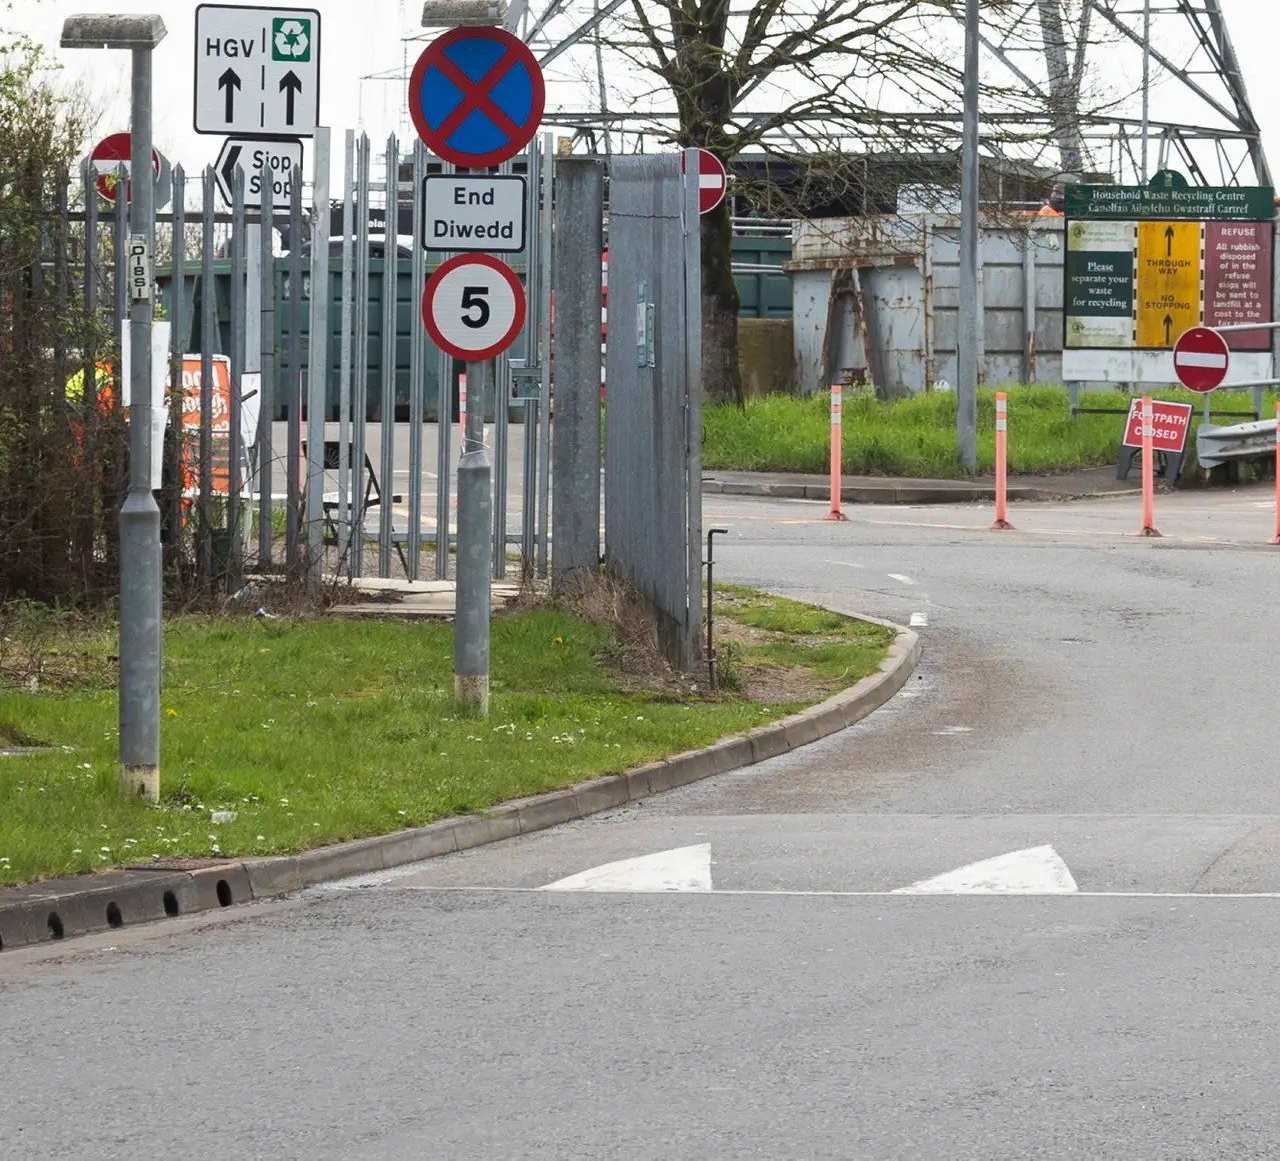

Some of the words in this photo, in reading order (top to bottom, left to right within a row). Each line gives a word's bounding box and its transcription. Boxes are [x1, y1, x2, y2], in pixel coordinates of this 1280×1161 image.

[206, 37, 255, 59] HGV
[252, 149, 291, 173] Siop
[249, 175, 291, 198] Sop
[454, 186, 495, 206] End
[1092, 189, 1141, 201] Household
[1143, 190, 1169, 201] Waste
[1172, 190, 1214, 203] Recycling
[1216, 190, 1246, 201] Centre
[1088, 202, 1128, 214] Canolfan
[1173, 202, 1216, 215] Gwastraff
[1217, 203, 1249, 215] Cartref
[433, 218, 513, 239] Diwedd
[1221, 227, 1256, 237] REFUSE
[1216, 242, 1229, 251] All
[1231, 242, 1261, 251] rubbish
[1220, 252, 1256, 262] disposed
[1087, 261, 1114, 272] Please
[1220, 262, 1229, 271] of
[1232, 262, 1240, 270] in
[1242, 262, 1256, 271] the
[1072, 275, 1107, 286] separate
[1108, 276, 1129, 286] your
[1225, 271, 1251, 281] refuse
[1242, 281, 1257, 290] will
[1088, 286, 1113, 296] waste
[1216, 290, 1227, 300] be
[1229, 291, 1247, 300] sent
[1249, 291, 1260, 300] to
[1072, 297, 1086, 308] for
[1088, 297, 1128, 310] recycling
[1161, 294, 1175, 303] NO
[460, 285, 491, 329] 5
[1145, 301, 1191, 310] STOPPING
[1244, 301, 1254, 310] at
[1214, 309, 1233, 319] cost
[1235, 309, 1246, 319] to
[1247, 309, 1261, 319] the
